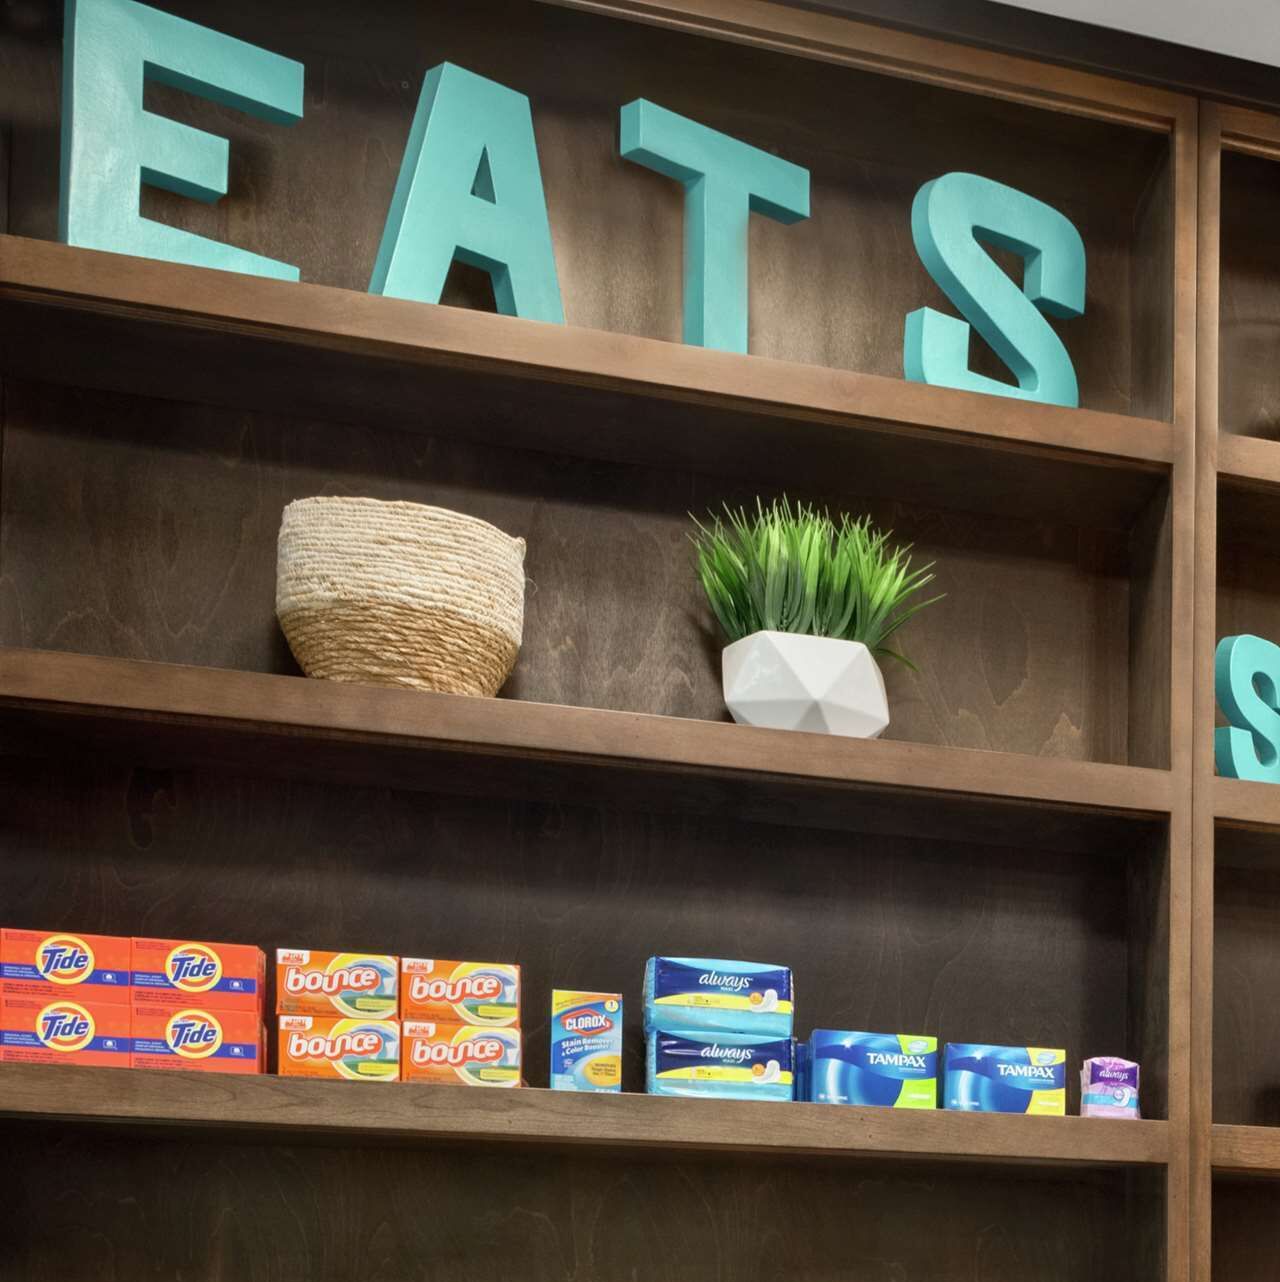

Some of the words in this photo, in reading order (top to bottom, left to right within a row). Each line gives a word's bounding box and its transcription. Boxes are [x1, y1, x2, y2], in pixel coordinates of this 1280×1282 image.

[60, 0, 1086, 407] EATS
[42, 946, 89, 974] Tide
[172, 955, 218, 982] Tide
[285, 965, 378, 995] bounce
[408, 974, 501, 1003] bounce
[698, 970, 753, 991] always
[42, 1013, 90, 1042] Tide
[172, 1021, 218, 1048] Tide
[565, 1014, 608, 1031] CLOROX
[287, 1030, 380, 1060] bounce
[411, 1037, 502, 1067] bounce
[700, 1043, 755, 1064] always
[866, 1053, 926, 1067] TAMPAX
[997, 1064, 1054, 1079] TAMPAX
